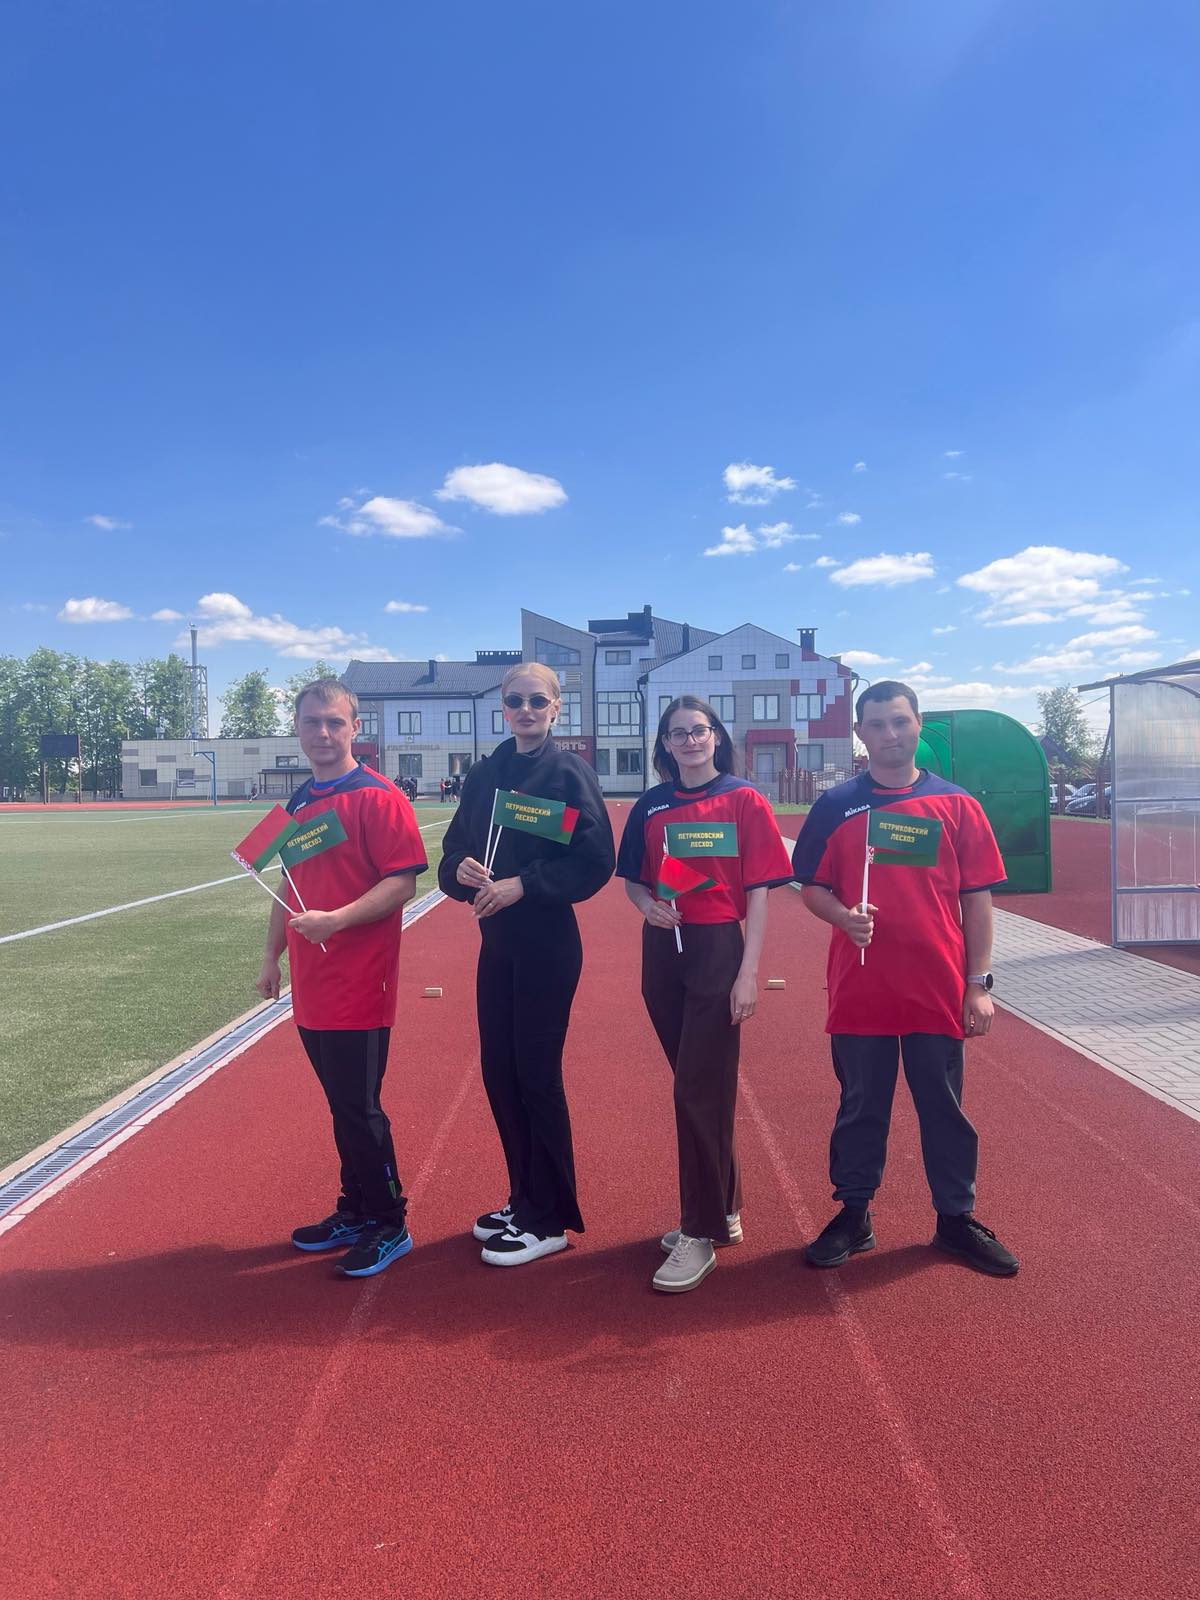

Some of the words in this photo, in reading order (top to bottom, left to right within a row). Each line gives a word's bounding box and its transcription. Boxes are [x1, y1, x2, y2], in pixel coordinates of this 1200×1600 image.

[505, 802, 551, 817] ПЕТРИКОВСКИЙ
[514, 813, 538, 824] ЛЕСХОЗ
[287, 822, 329, 848] ПЕТРИКОВСКИЙ
[678, 831, 724, 840] ПЕТРИКОВСКИЙ
[879, 822, 929, 836] ПЕТРИКОВСКИЙ
[301, 836, 322, 851] ЛЕСХОЗ
[890, 833, 915, 843] ЛЕСХОЗ
